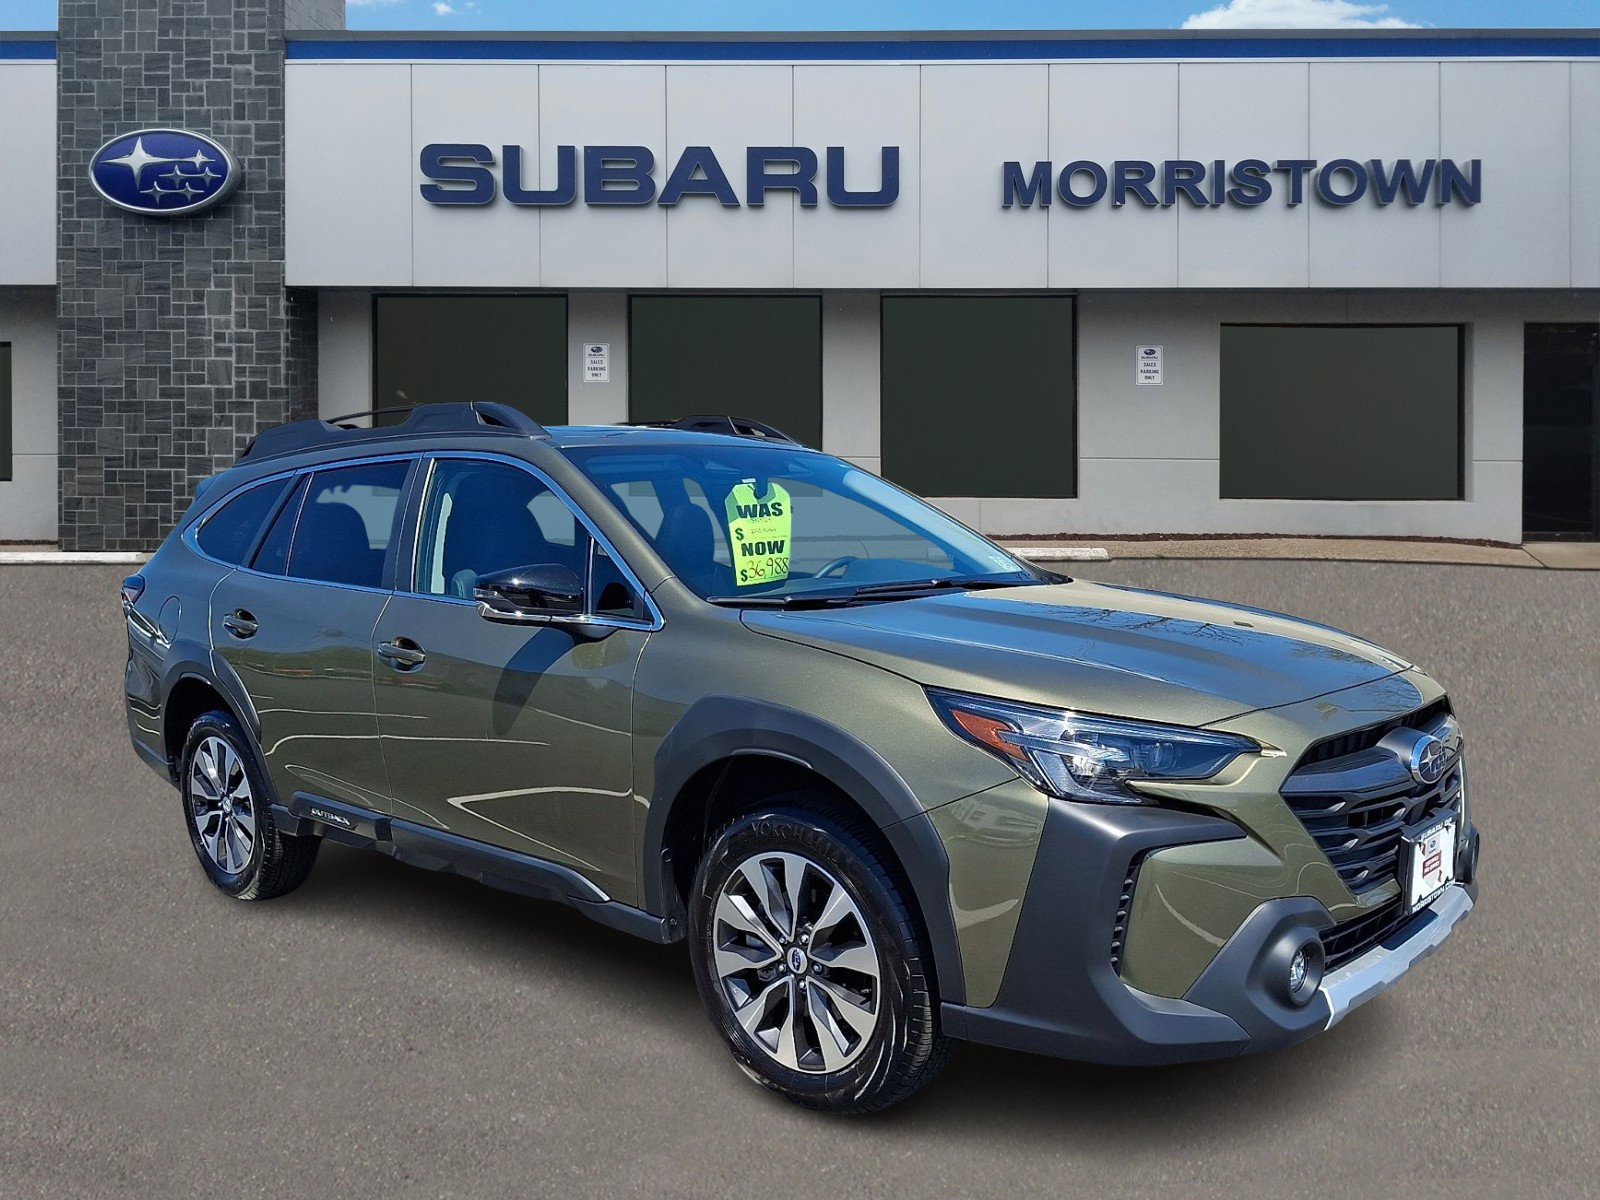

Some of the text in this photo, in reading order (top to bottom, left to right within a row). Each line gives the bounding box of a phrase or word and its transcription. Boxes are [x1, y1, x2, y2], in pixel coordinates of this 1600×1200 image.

[419, 143, 1482, 208] SUBARU MORRISTOWN
[736, 502, 784, 519] WAS
[734, 527, 745, 541] $
[741, 540, 786, 557] NOW
[311, 806, 350, 826] OUTBACK
